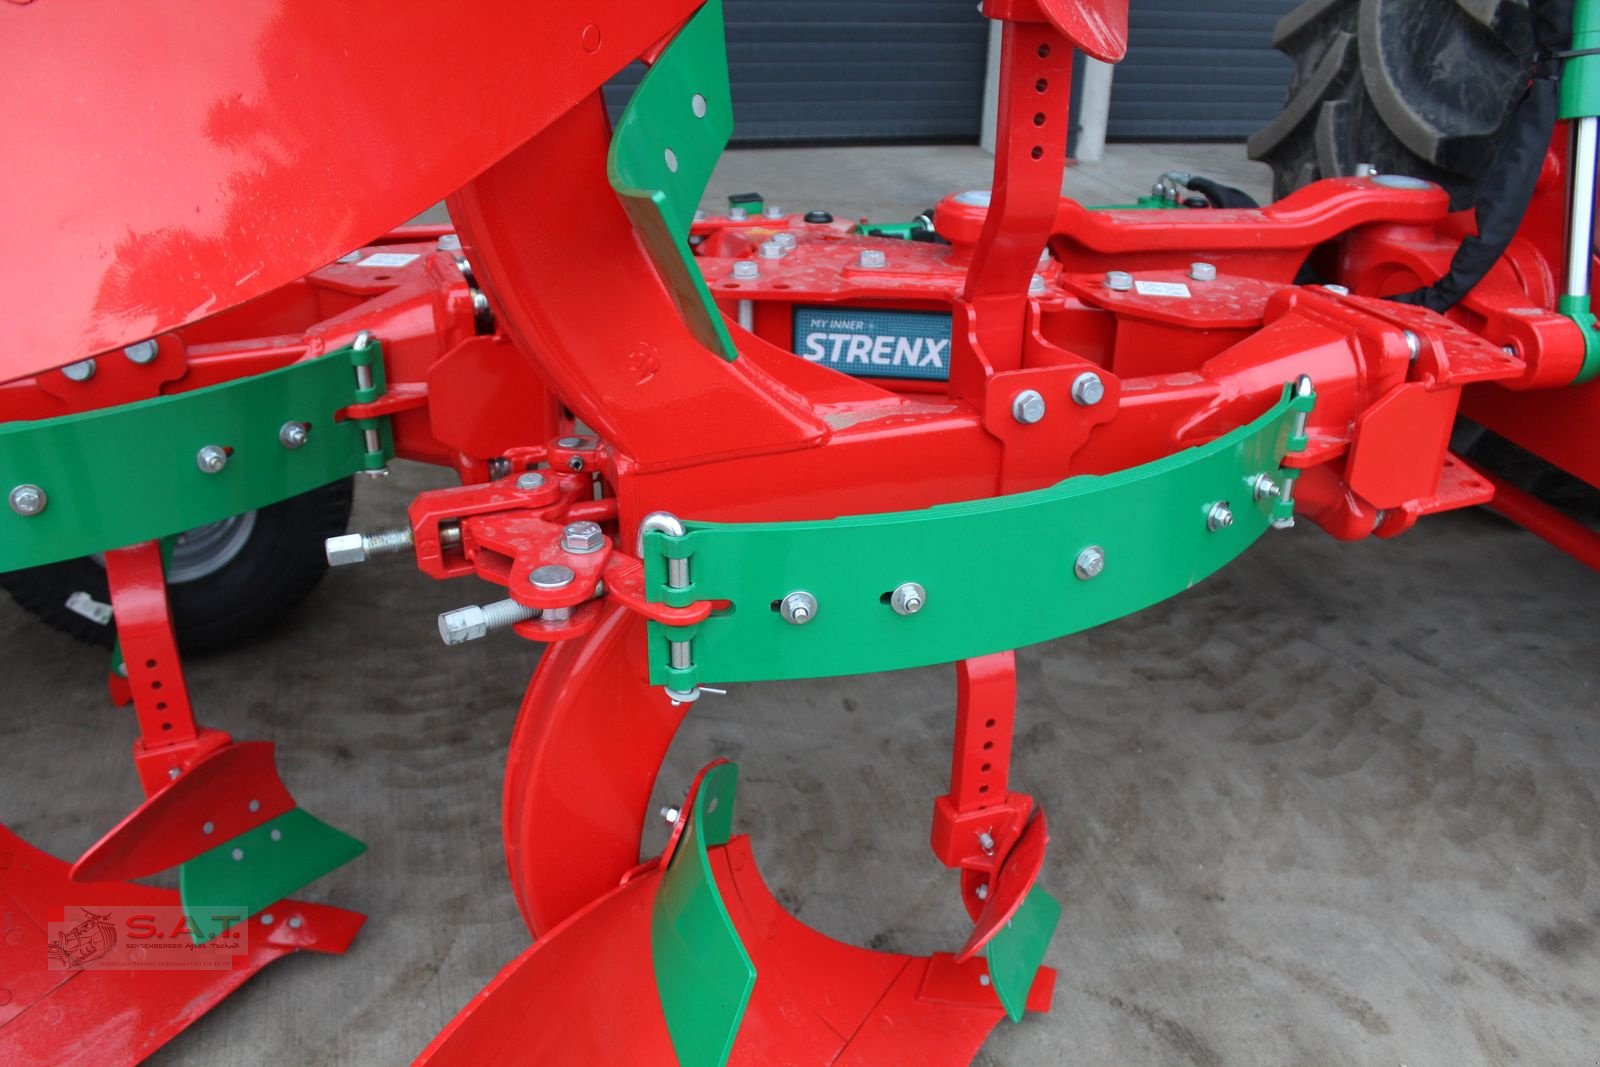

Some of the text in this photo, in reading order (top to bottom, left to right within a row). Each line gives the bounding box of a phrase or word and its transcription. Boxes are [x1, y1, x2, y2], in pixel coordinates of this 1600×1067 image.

[810, 319, 864, 331] MY INNER
[803, 332, 949, 368] STRENX
